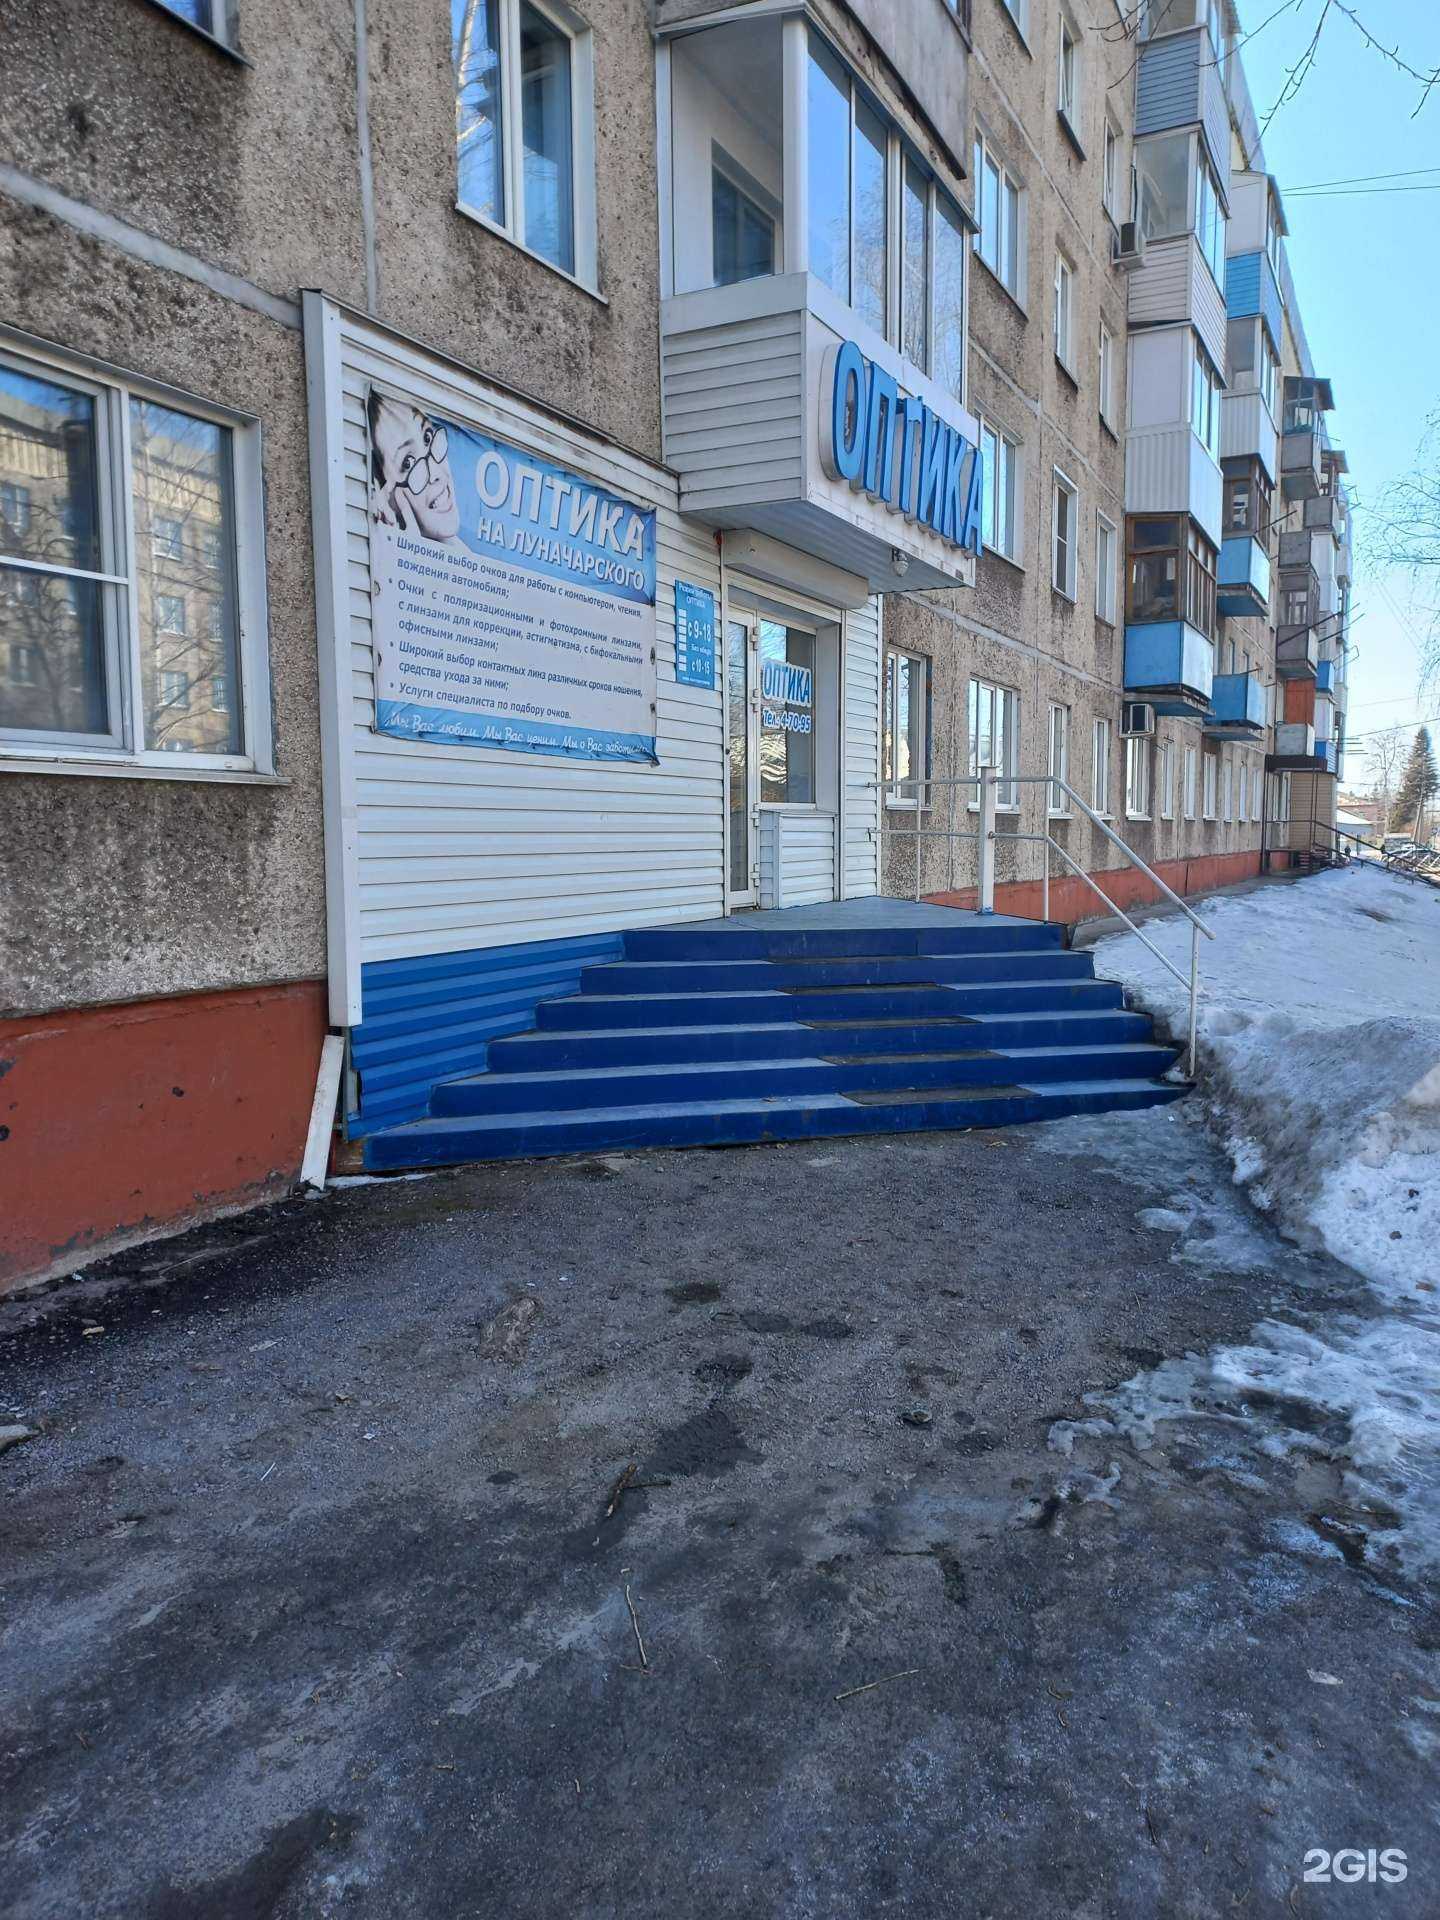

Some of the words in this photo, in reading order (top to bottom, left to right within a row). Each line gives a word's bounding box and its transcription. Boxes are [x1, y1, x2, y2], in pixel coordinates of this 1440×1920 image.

[832, 340, 983, 558] ОПТИКА
[475, 451, 645, 561] ОПТИКА
[397, 536, 445, 560] Широкий
[448, 555, 478, 572] выбор
[481, 565, 507, 580] очков
[508, 573, 525, 585] для
[527, 578, 556, 595] работы
[564, 590, 616, 612] компьютером,
[397, 558, 449, 581] вождения
[451, 574, 510, 599] автомобиля;
[477, 517, 506, 549] НА
[510, 528, 645, 591] ЛУНАЧАРСКОГО
[398, 579, 424, 596] Очки
[431, 590, 437, 600] с
[443, 593, 534, 624] поляризационными
[550, 618, 607, 642] фотохромными
[398, 600, 404, 610] с
[407, 602, 450, 621] линзами
[453, 615, 470, 626] для
[473, 619, 523, 641] коррекции,
[526, 632, 582, 653] астигматизма,
[590, 644, 643, 665] бифокальными
[398, 620, 453, 640] офисными
[456, 634, 499, 652] линзами;
[399, 640, 444, 661] Широкий
[446, 653, 475, 667] выбор
[477, 659, 526, 677] контактных
[527, 668, 546, 680] линз
[548, 672, 588, 688] различных
[588, 681, 612, 692] сроков
[399, 661, 441, 678] средства
[444, 670, 470, 684] ухода
[472, 675, 482, 685] за
[484, 680, 510, 691] ними;
[762, 661, 810, 704] ОПТИКА
[399, 682, 433, 699] Услуги
[436, 690, 495, 709] специалиста
[497, 700, 508, 710] по
[511, 702, 544, 717] подбору
[546, 707, 572, 720] очков.
[481, 725, 502, 740] Мы
[504, 727, 524, 743] Вас
[561, 735, 578, 749] Мы
[587, 737, 603, 752] Вас
